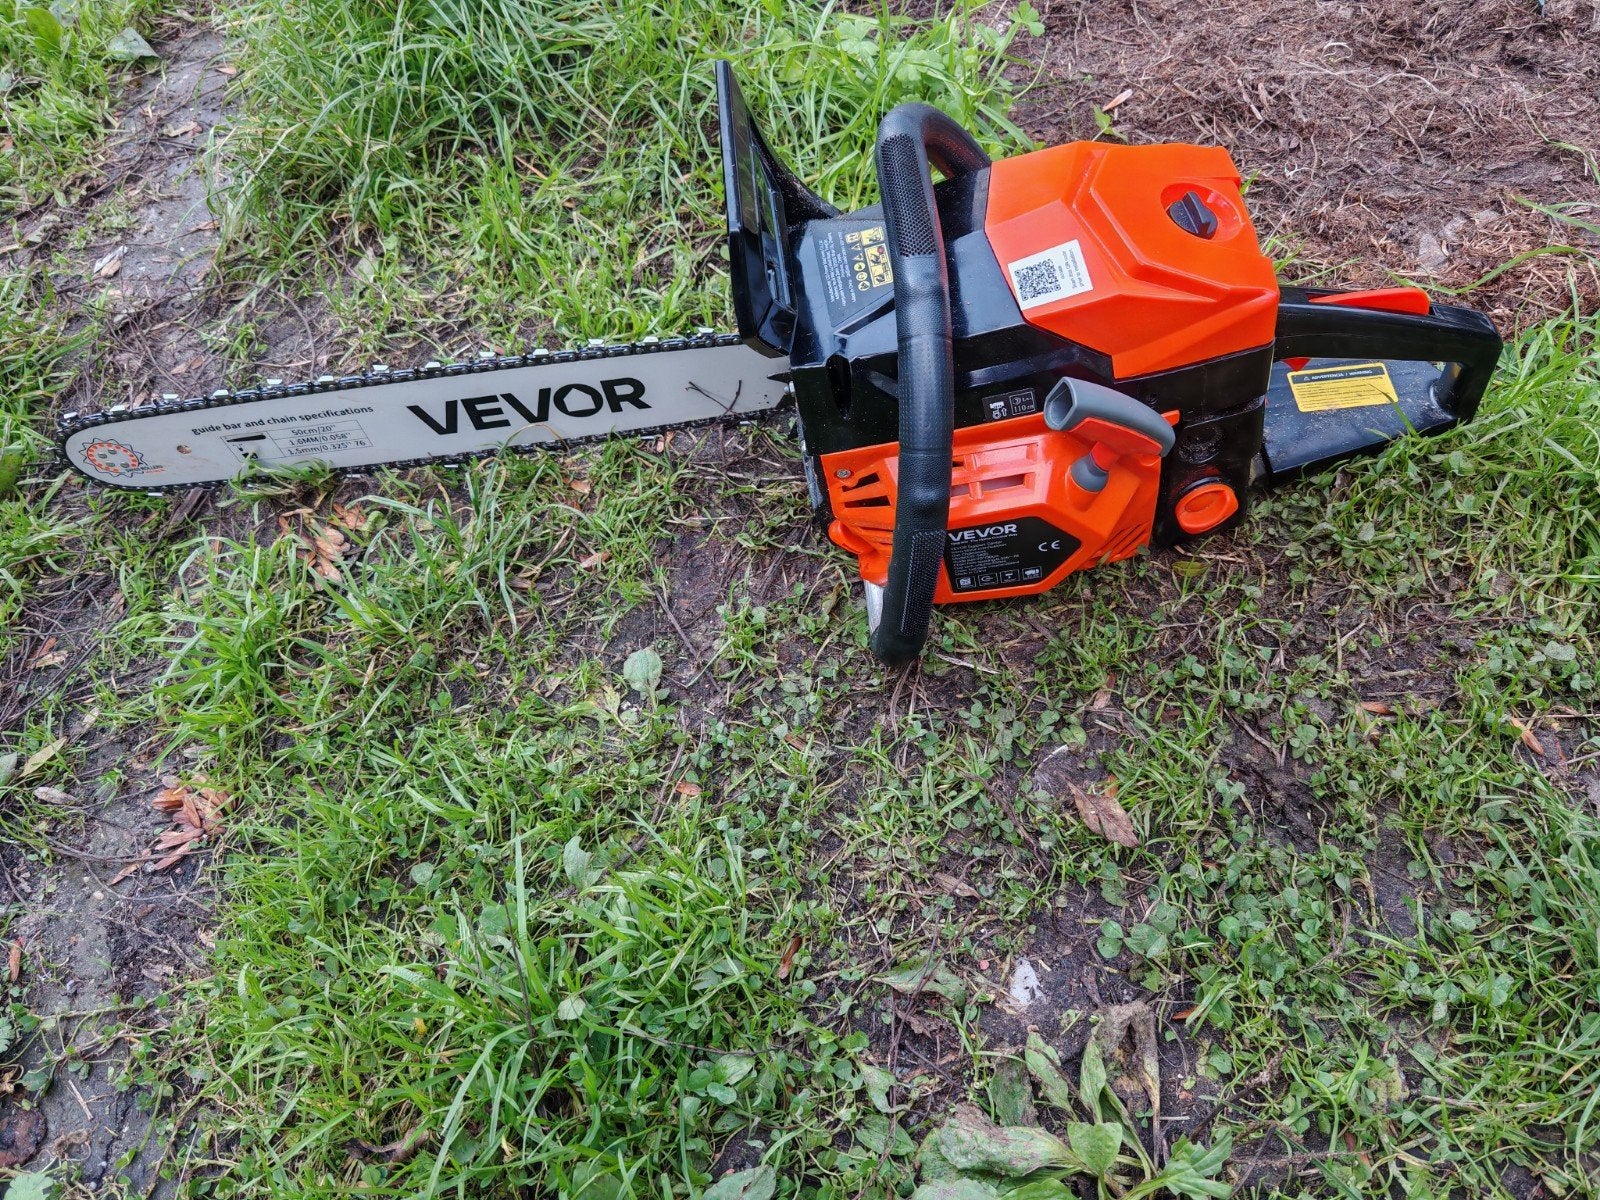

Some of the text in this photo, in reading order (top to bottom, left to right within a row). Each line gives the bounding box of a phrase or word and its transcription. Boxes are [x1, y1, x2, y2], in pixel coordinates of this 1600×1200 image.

[406, 377, 652, 436] VEVOR
[192, 406, 374, 436] guide bar and chain specifications
[948, 524, 1017, 541] VEVOR
[1038, 540, 1060, 552] CE
